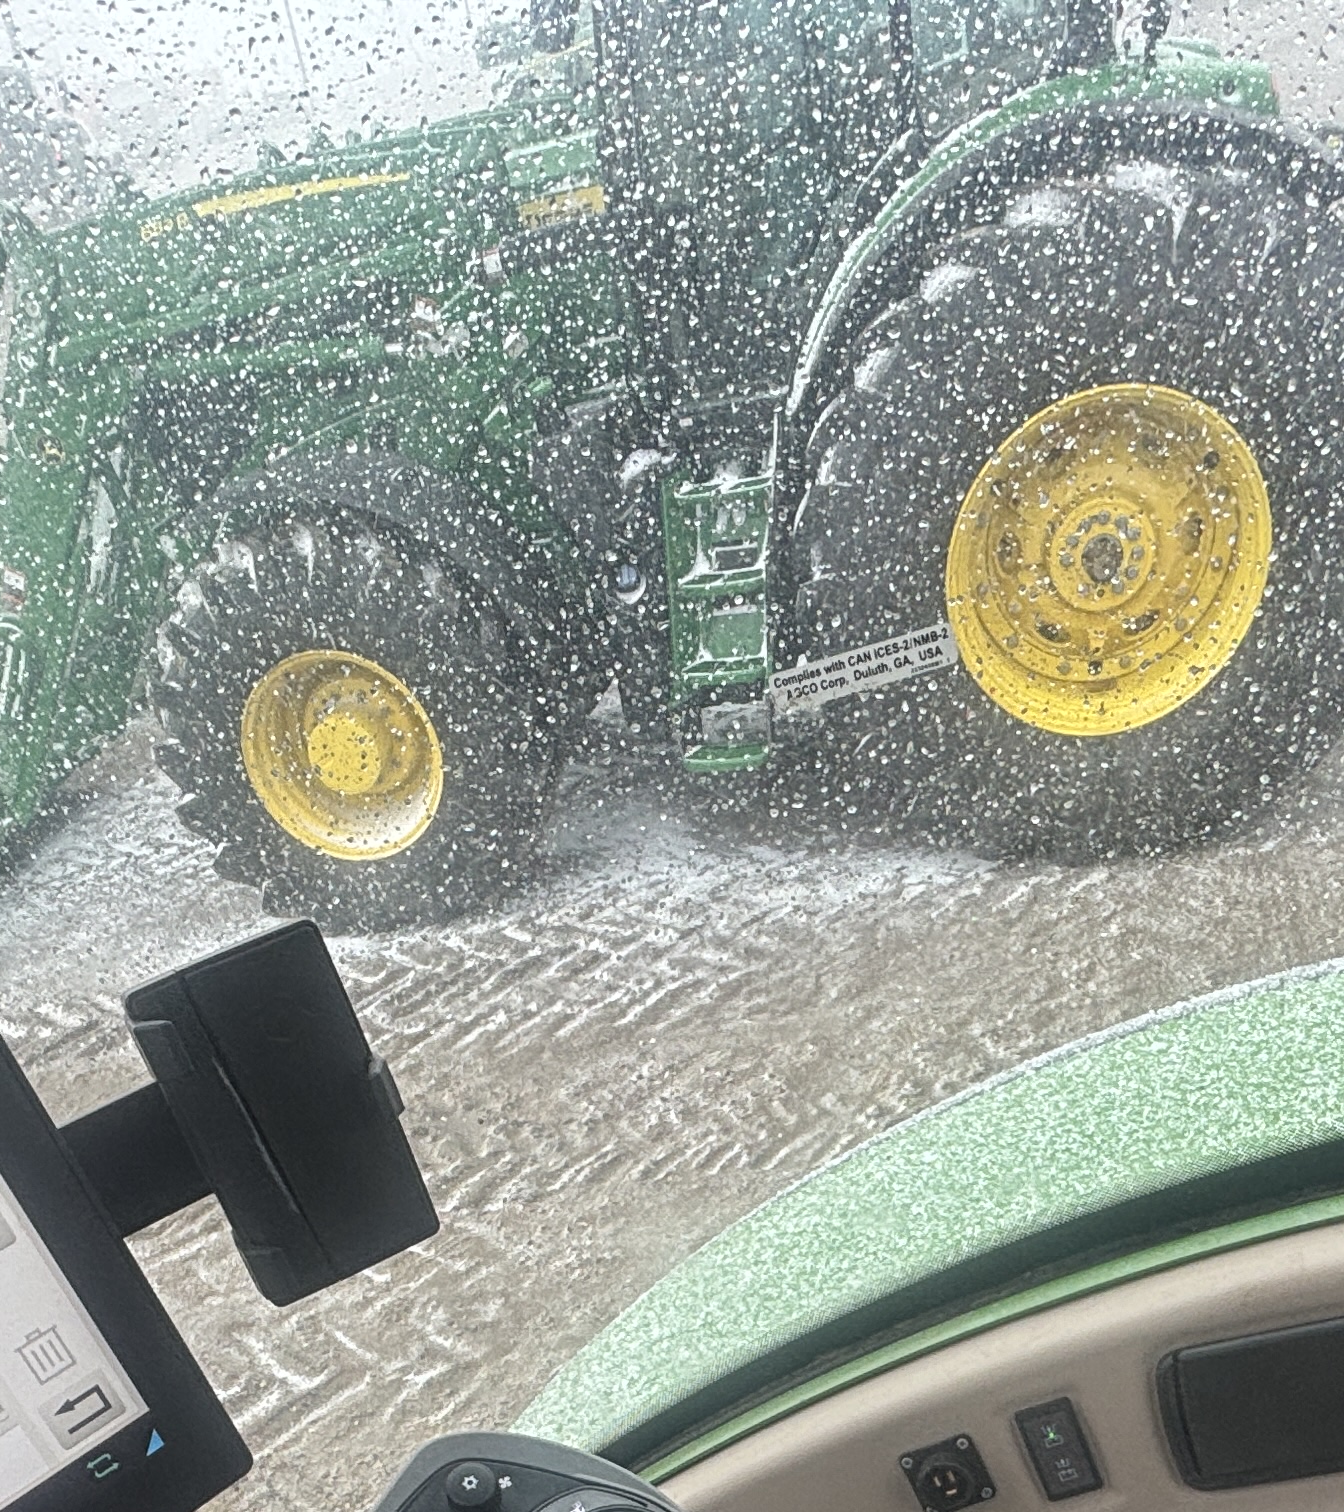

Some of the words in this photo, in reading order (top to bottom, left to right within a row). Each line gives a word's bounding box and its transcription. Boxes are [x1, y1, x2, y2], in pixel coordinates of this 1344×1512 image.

[774, 667, 822, 688] Complies
[823, 660, 846, 675] with
[847, 650, 872, 667] CAN
[873, 627, 949, 660] ICES-2/NMB-2
[853, 662, 892, 680] Duluth,
[918, 645, 943, 661] USA
